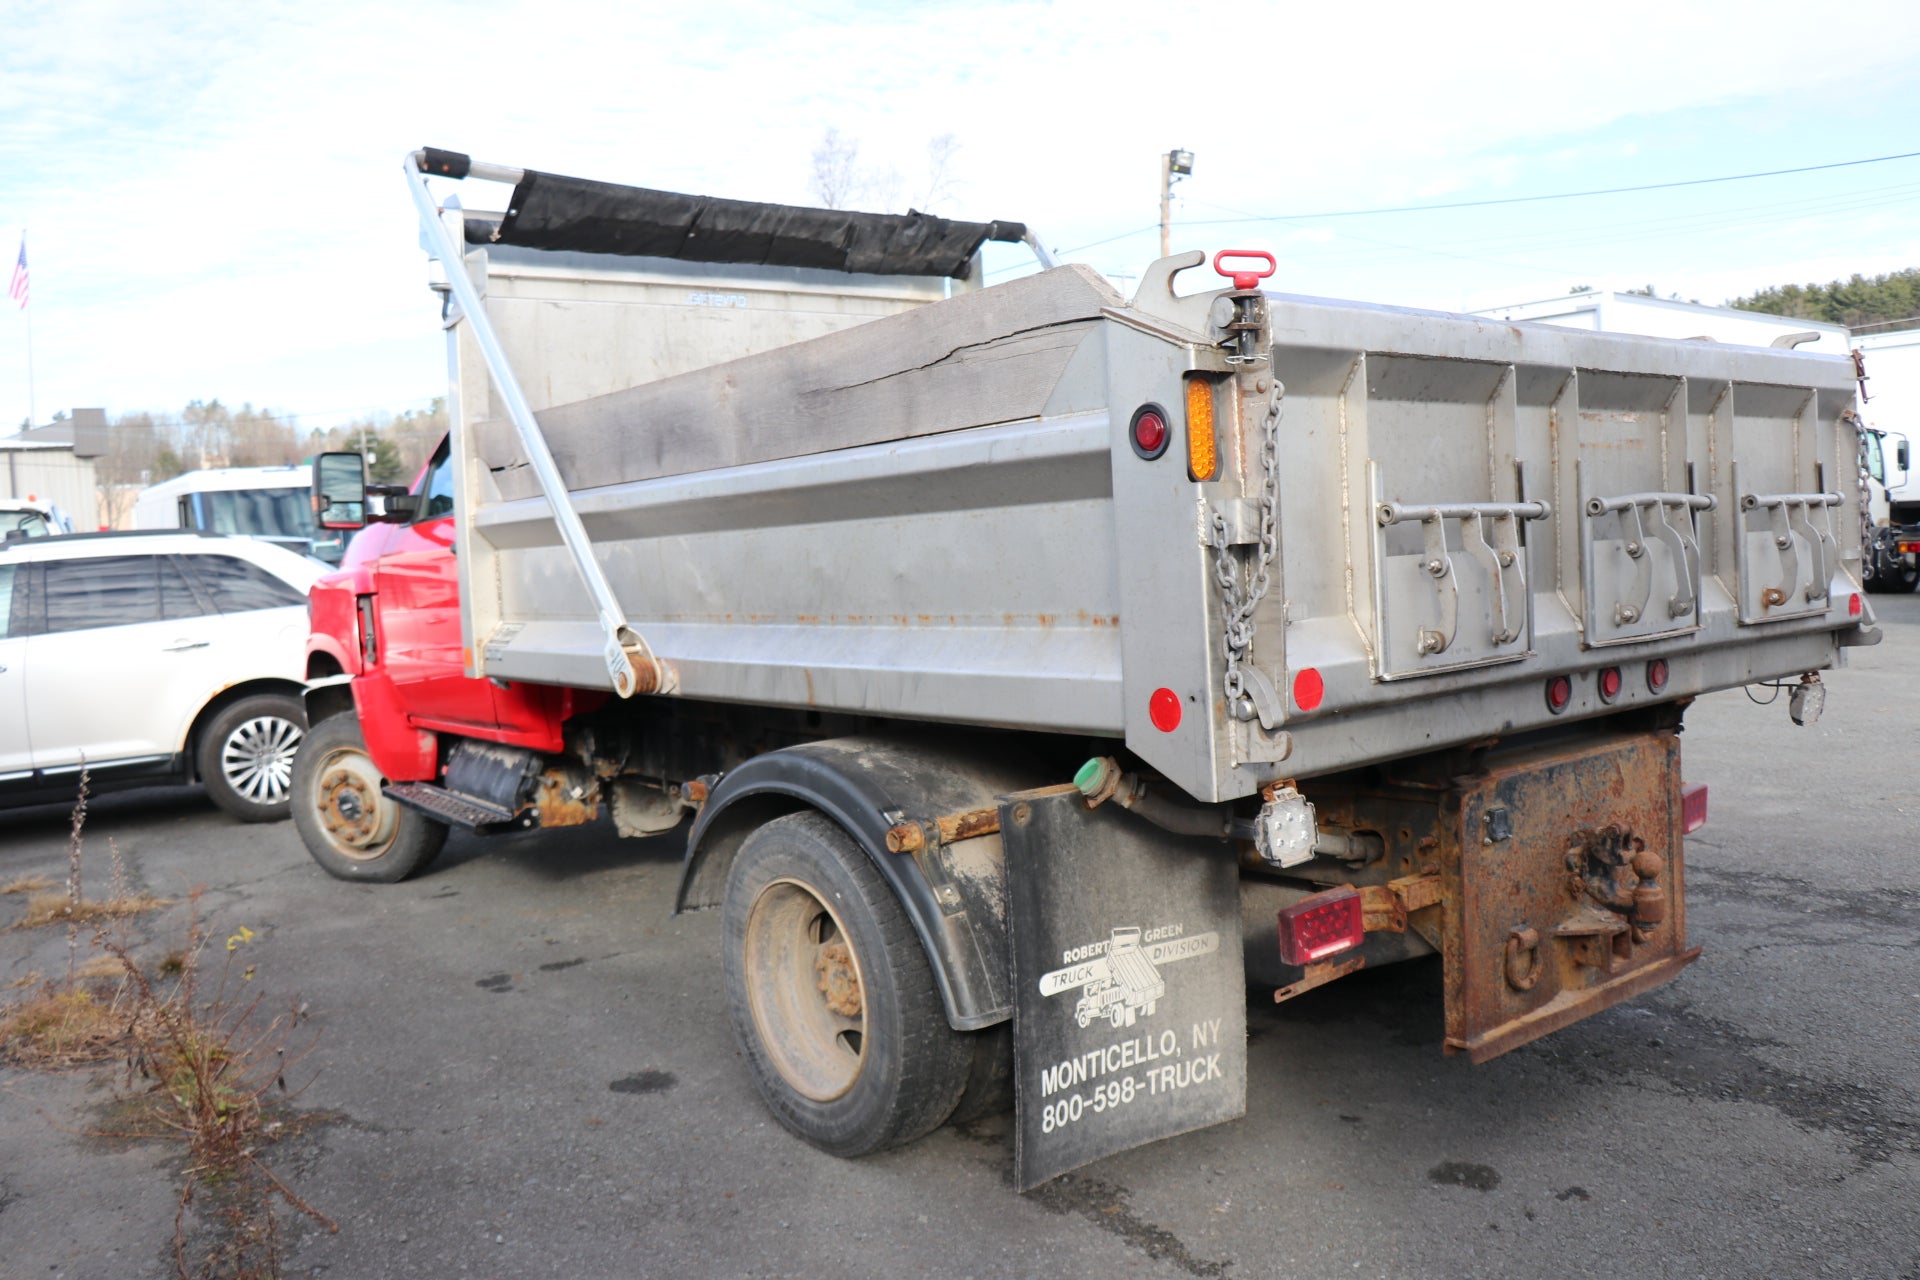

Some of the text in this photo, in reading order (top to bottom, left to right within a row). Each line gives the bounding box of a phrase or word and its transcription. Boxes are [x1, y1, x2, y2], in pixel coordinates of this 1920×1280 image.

[1052, 936, 1208, 988] TRUCK DIVISION
[1063, 923, 1183, 964] ROBERT GREEN
[1041, 1018, 1221, 1097] MONTICELLO, NY
[1042, 1053, 1221, 1133] 800-598-TRUCK
